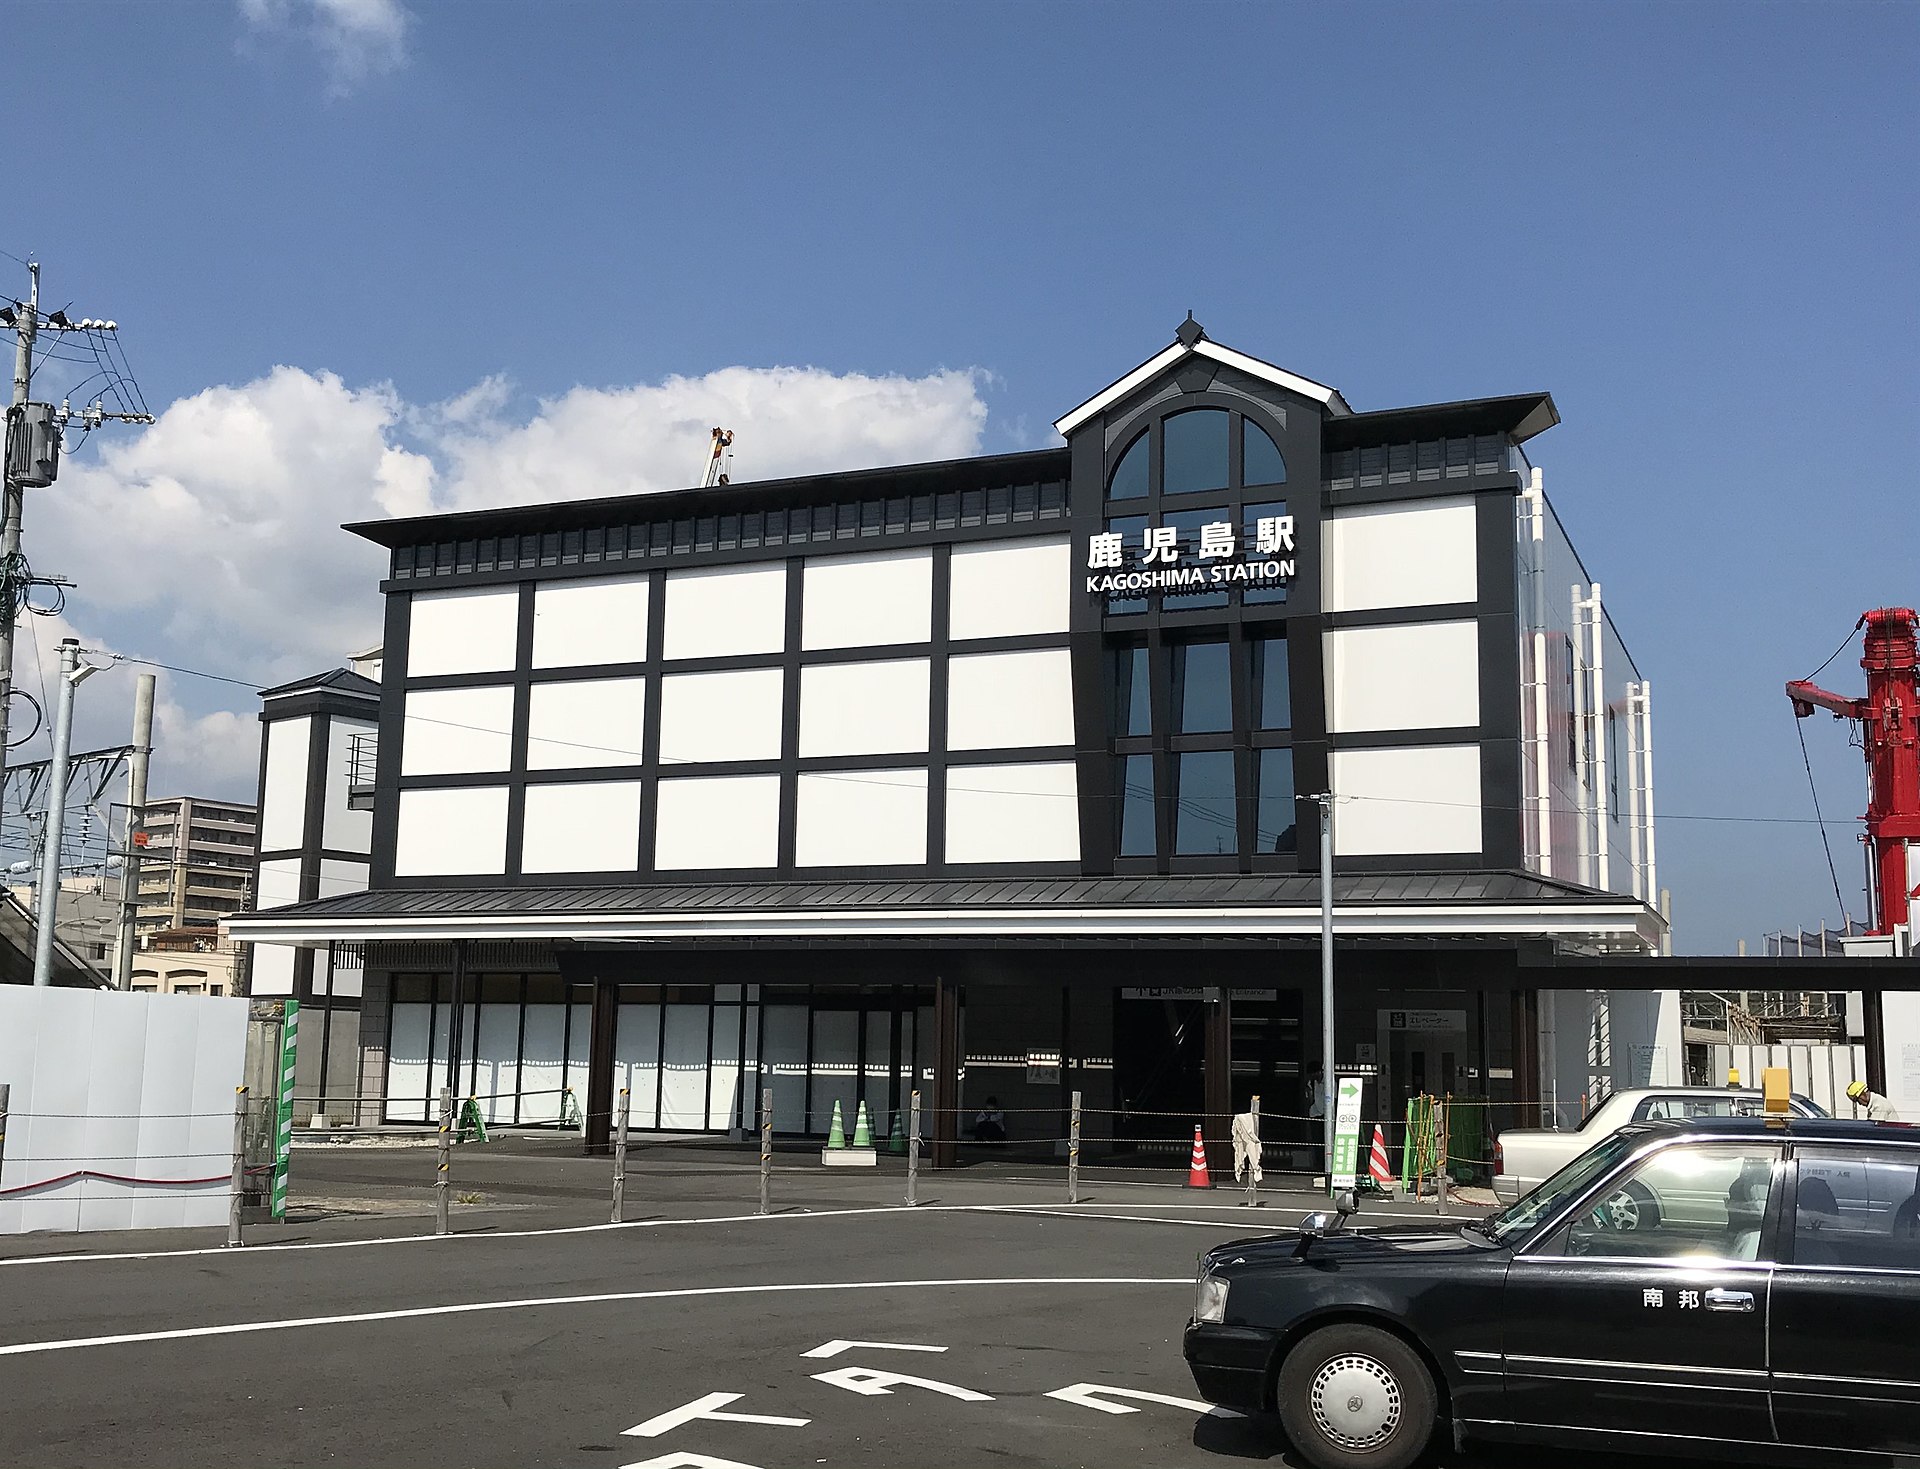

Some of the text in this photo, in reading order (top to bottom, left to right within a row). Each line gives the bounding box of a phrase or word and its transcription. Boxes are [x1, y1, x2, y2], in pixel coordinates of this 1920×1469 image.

[1086, 515, 1295, 569] 鹿児島駅
[1086, 559, 1295, 592] KAGOSHIMA STATION
[1643, 1287, 1700, 1309] 南邦
